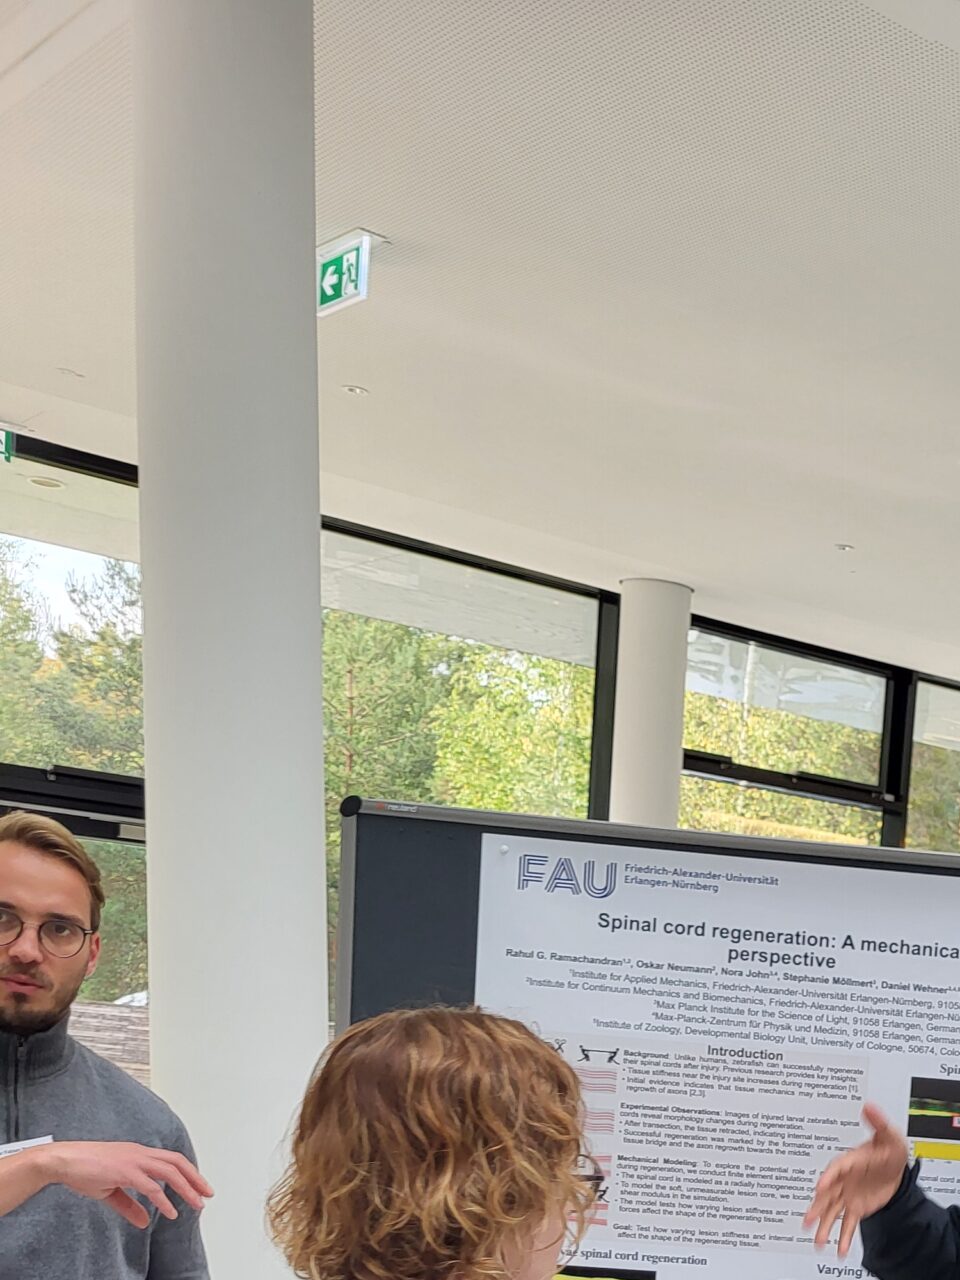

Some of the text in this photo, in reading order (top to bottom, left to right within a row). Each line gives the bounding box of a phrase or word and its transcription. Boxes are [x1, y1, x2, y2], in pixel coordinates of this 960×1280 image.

[518, 854, 617, 899] FAU
[624, 875, 718, 893] Erlangen-Nürnberg
[625, 864, 778, 885] Friedrich-Alexander-Universität
[598, 913, 656, 932] Spinal
[663, 922, 705, 936] cord
[712, 927, 835, 947] regeneration:
[841, 935, 855, 950] A
[728, 949, 835, 968] perspective
[567, 981, 579, 989] for
[582, 982, 630, 993] Continuum
[633, 987, 680, 998] Mechanics
[682, 992, 700, 1000] and
[702, 992, 765, 1006] Biomechanics,
[769, 998, 903, 1016] Friedrich-Alexander-Universität
[610, 972, 622, 981] for
[623, 974, 657, 984] Applied
[659, 977, 709, 989] Mechanics,
[713, 981, 847, 1000] Friedrich-Alexander-Universität
[850, 993, 934, 1009] Erlangen-Nürnberg,
[678, 1002, 707, 1012] Planck
[710, 1005, 745, 1015] Institute
[747, 1007, 759, 1016] for
[761, 1009, 775, 1018] the
[778, 1010, 812, 1021] Science
[815, 1013, 824, 1022] of
[826, 1014, 849, 1025] Light,
[852, 1017, 879, 1026] 91058
[882, 1019, 923, 1031] Erlangen,
[633, 1022, 643, 1030] of
[645, 1023, 681, 1035] Zoology,
[685, 1026, 750, 1039] Developmental
[753, 1032, 785, 1043] Biology
[788, 1035, 807, 1045] Unit,
[810, 1036, 853, 1049] University
[855, 1040, 865, 1048] of
[866, 1041, 905, 1052] Cologne,
[908, 1044, 937, 1055] 50674,
[749, 1020, 761, 1028] für
[763, 1021, 792, 1031] Physik
[813, 1025, 849, 1036] Medizin,
[852, 1028, 879, 1038] 91058
[882, 1030, 923, 1042] Erlangen,
[707, 1045, 783, 1060] Introduction
[580, 1248, 707, 1265] spinal cord regeneration
[817, 1264, 865, 1279] Varying
